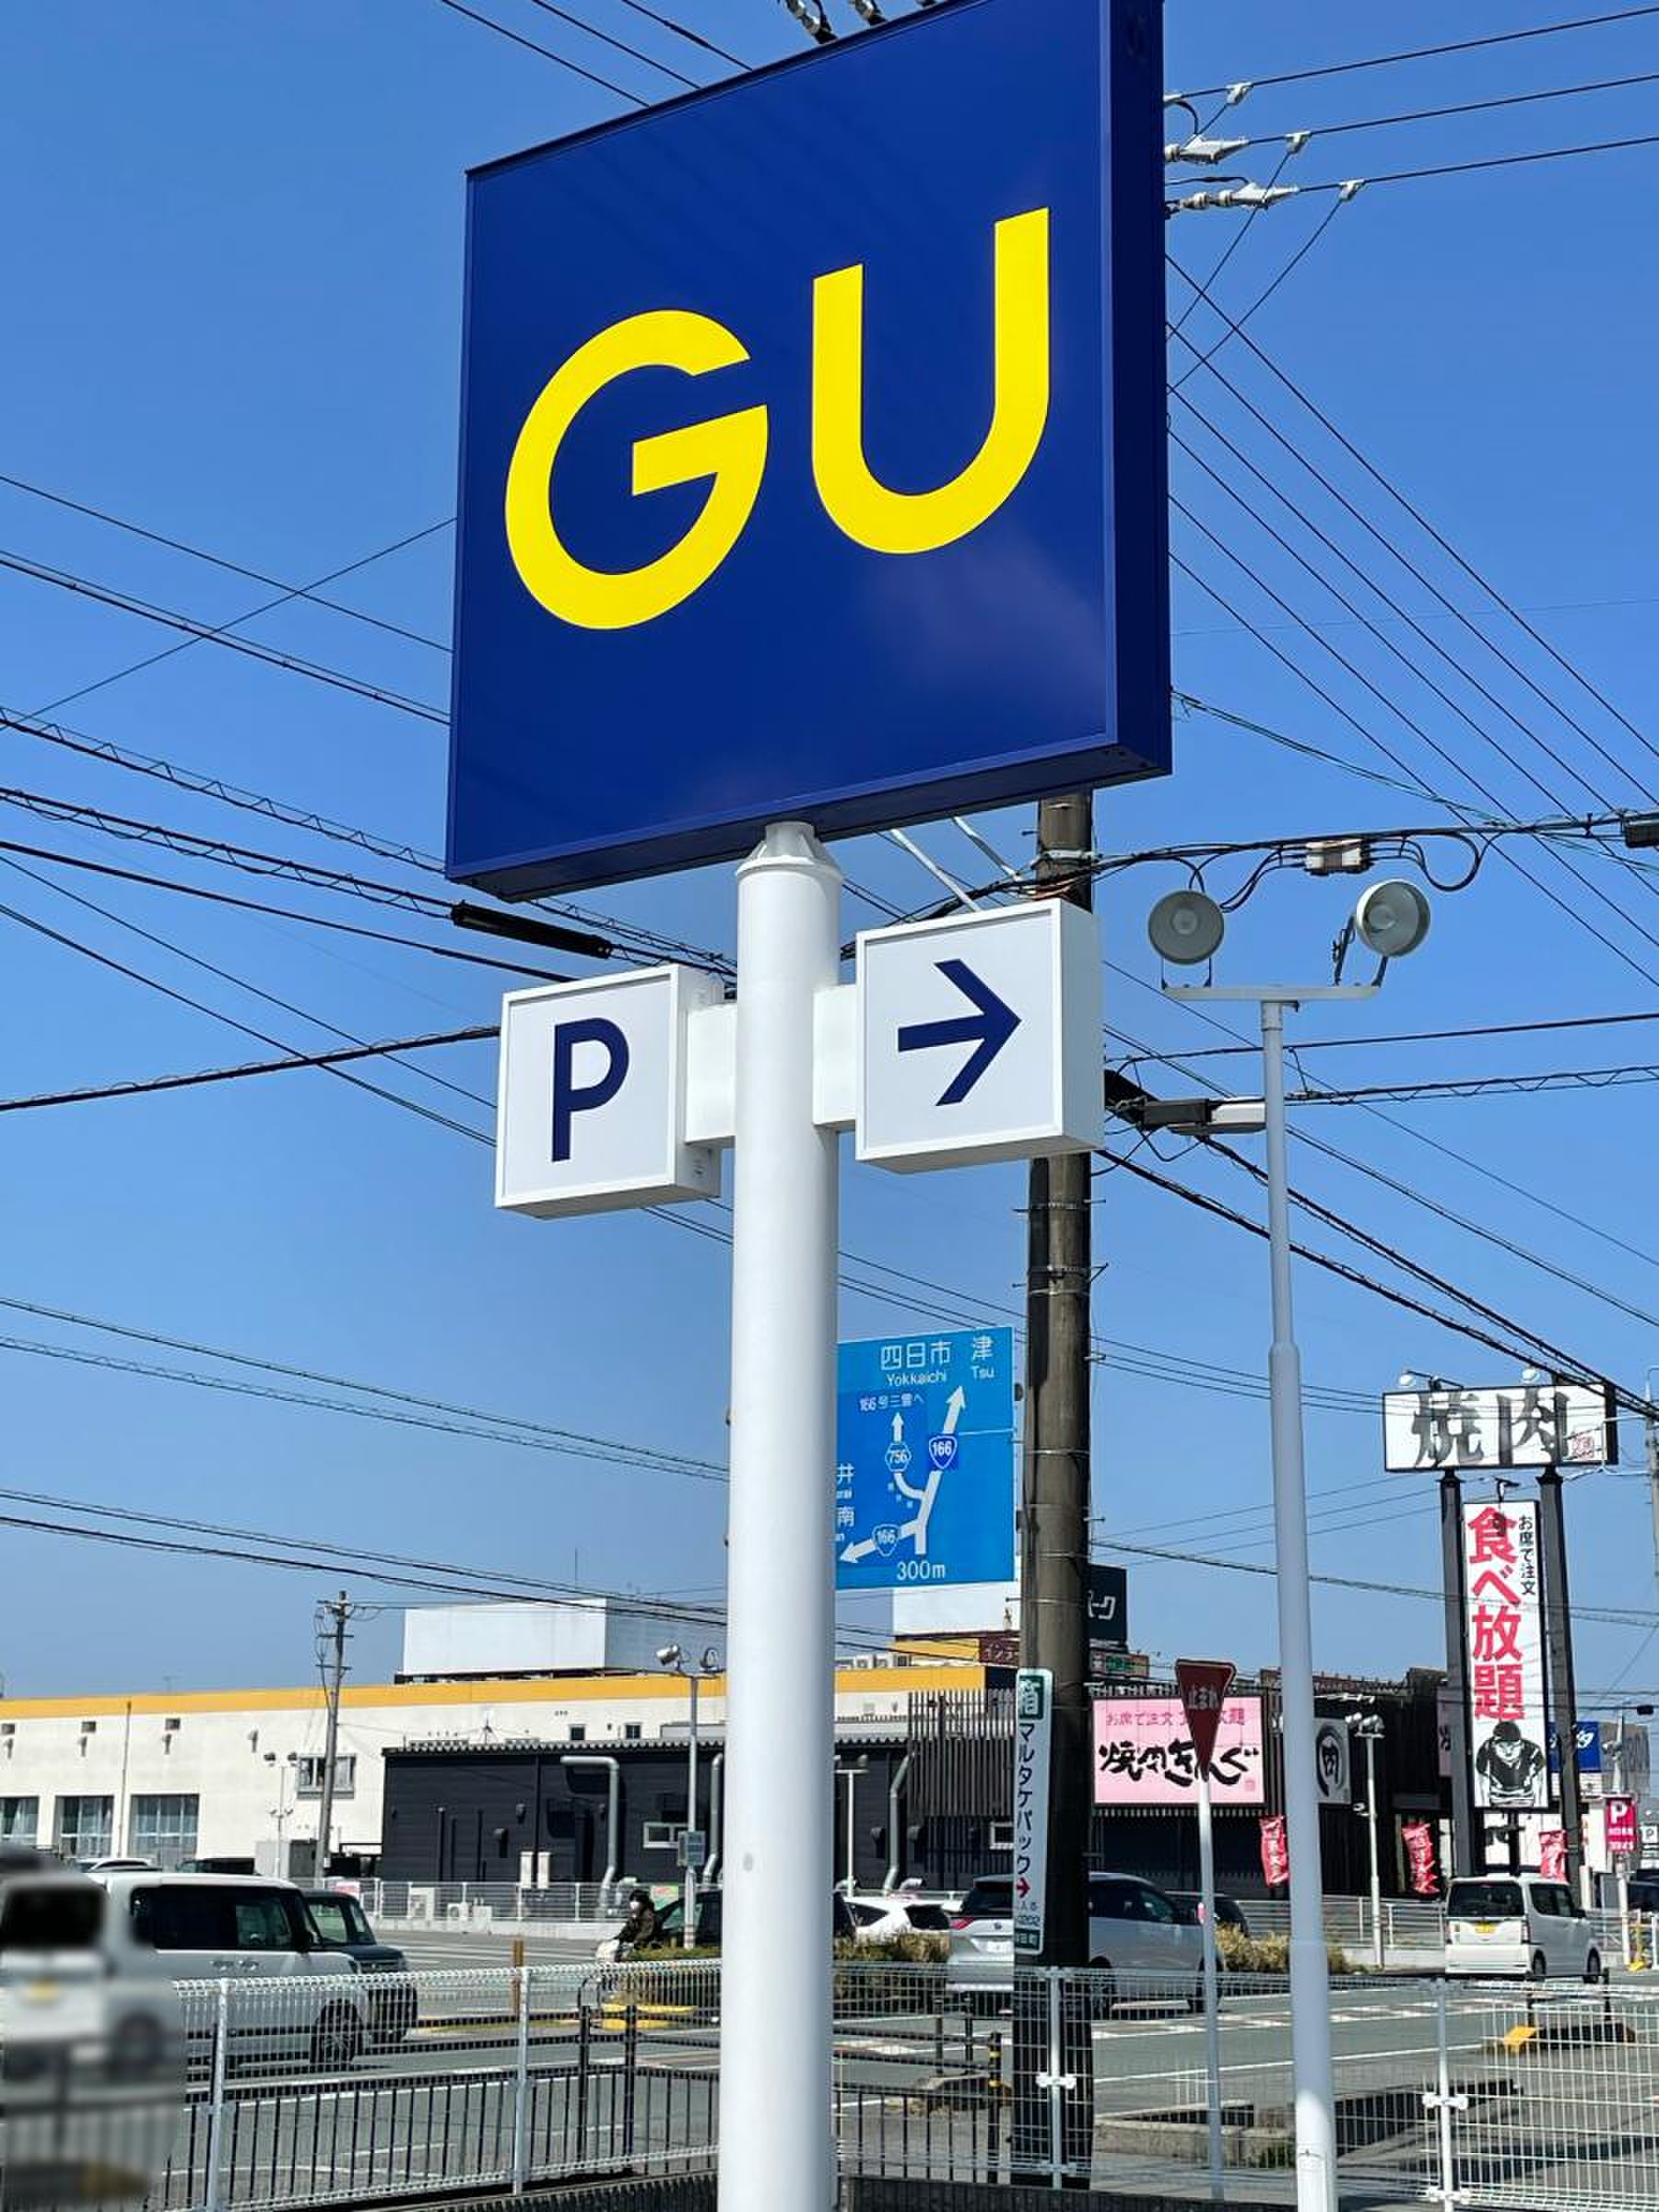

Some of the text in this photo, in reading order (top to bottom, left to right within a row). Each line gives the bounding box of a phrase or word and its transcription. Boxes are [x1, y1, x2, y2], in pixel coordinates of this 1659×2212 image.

[505, 207, 1050, 630] GU
[553, 1017, 629, 1162] P
[880, 1335, 993, 1371] 四日市 津
[887, 1365, 994, 1387] Yokkaichi Tsu
[1411, 1390, 1571, 1468] 焼肉
[889, 1449, 908, 1465] 756
[933, 1441, 952, 1457] 166
[897, 1561, 946, 1580] 300m
[1518, 1515, 1537, 1596] お席で注文
[1467, 1506, 1525, 1721] 食べ放題
[1610, 1800, 1629, 1824] P
